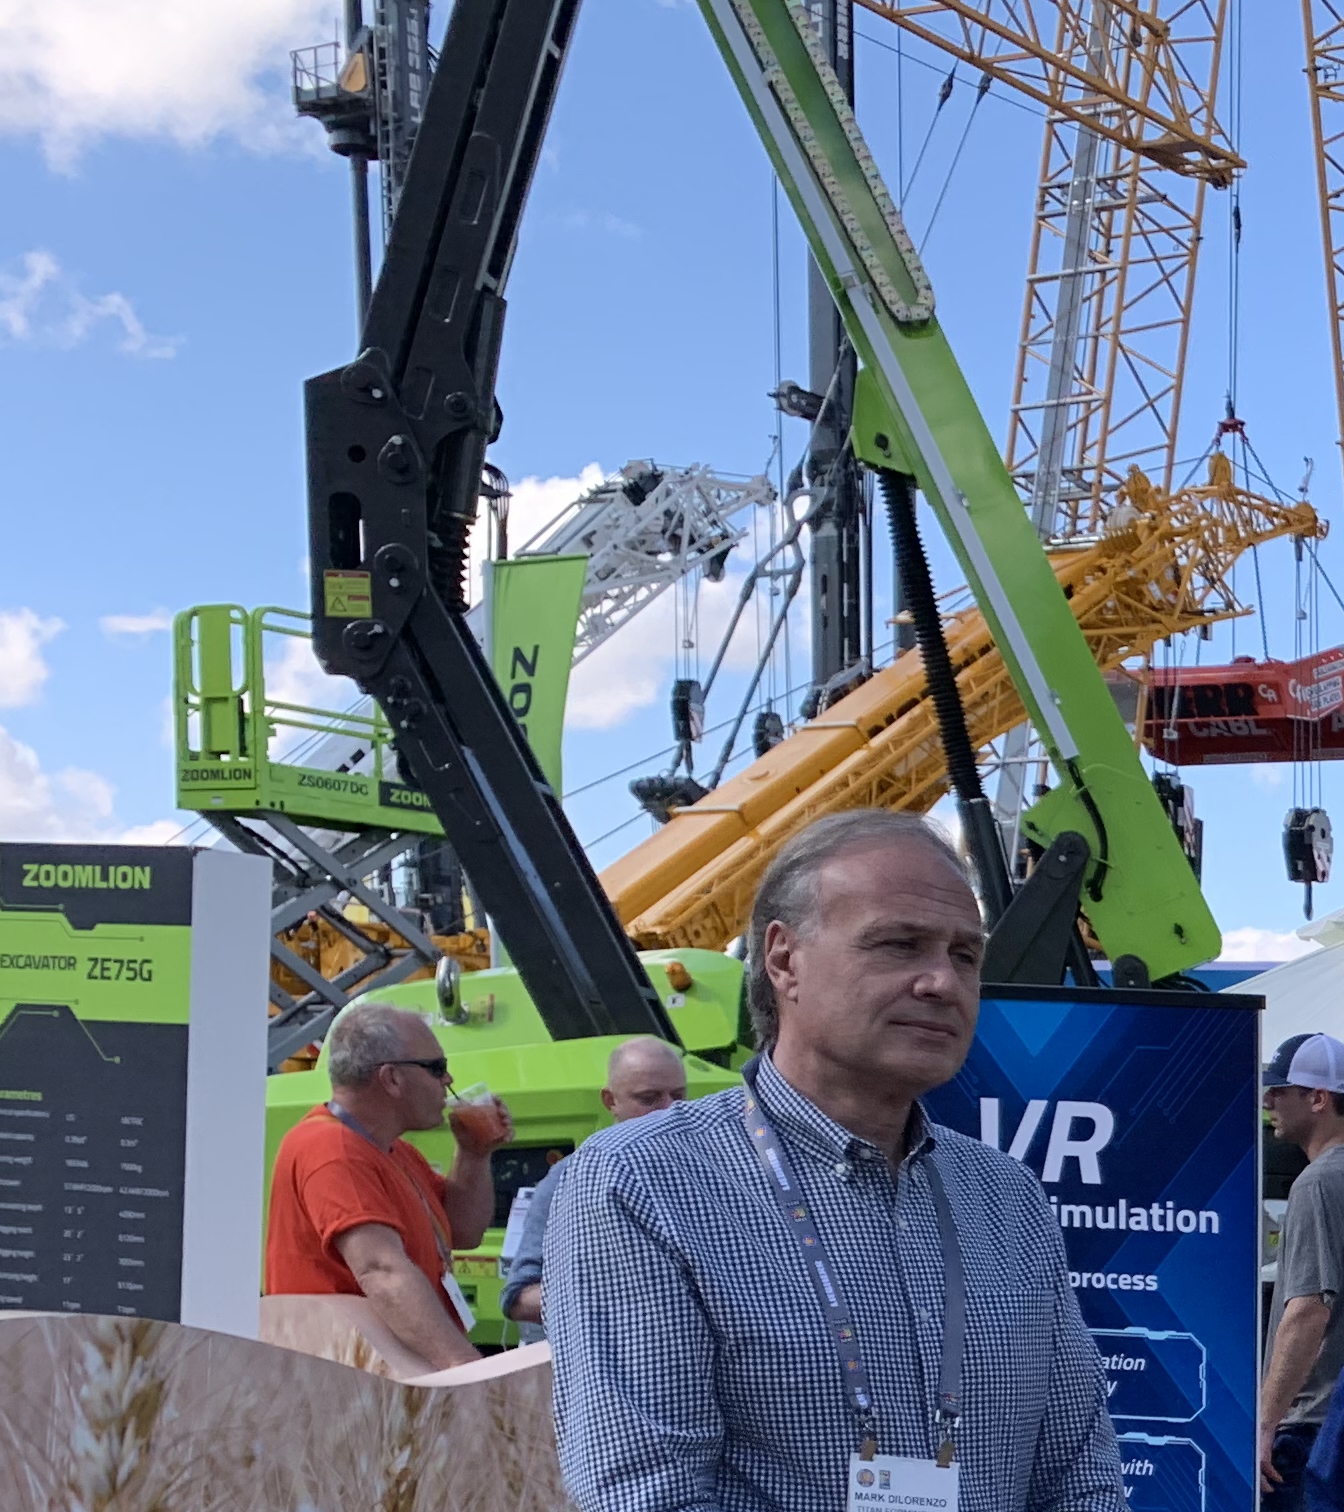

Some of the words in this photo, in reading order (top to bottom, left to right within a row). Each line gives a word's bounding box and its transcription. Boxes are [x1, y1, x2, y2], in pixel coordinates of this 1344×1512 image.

[181, 768, 252, 783] ZOOMLION
[22, 863, 151, 889] ZOOMLION
[0, 954, 77, 971] EXCAVATOR
[87, 957, 153, 983] ZE75G
[980, 1097, 1114, 1185] VR
[1050, 1199, 1220, 1234] imulation
[1068, 1270, 1158, 1292] process
[1100, 1354, 1146, 1372] ation
[854, 1492, 885, 1503] MARK
[888, 1494, 947, 1508] DILORENZO
